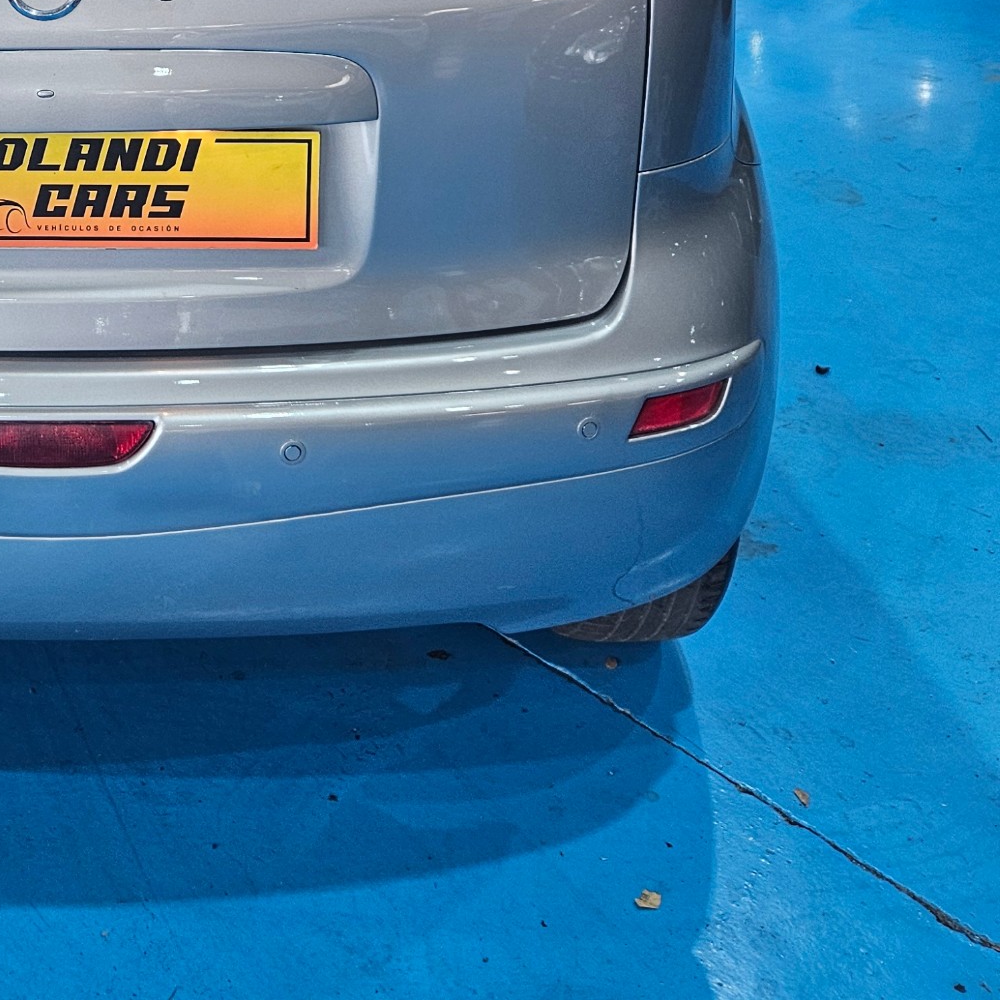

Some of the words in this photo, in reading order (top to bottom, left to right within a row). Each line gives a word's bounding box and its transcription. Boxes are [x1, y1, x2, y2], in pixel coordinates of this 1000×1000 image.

[32, 184, 190, 218] CARS
[36, 223, 99, 232] VEHÍCULOS
[108, 224, 122, 232] DE
[130, 224, 180, 232] OCASIÓN
